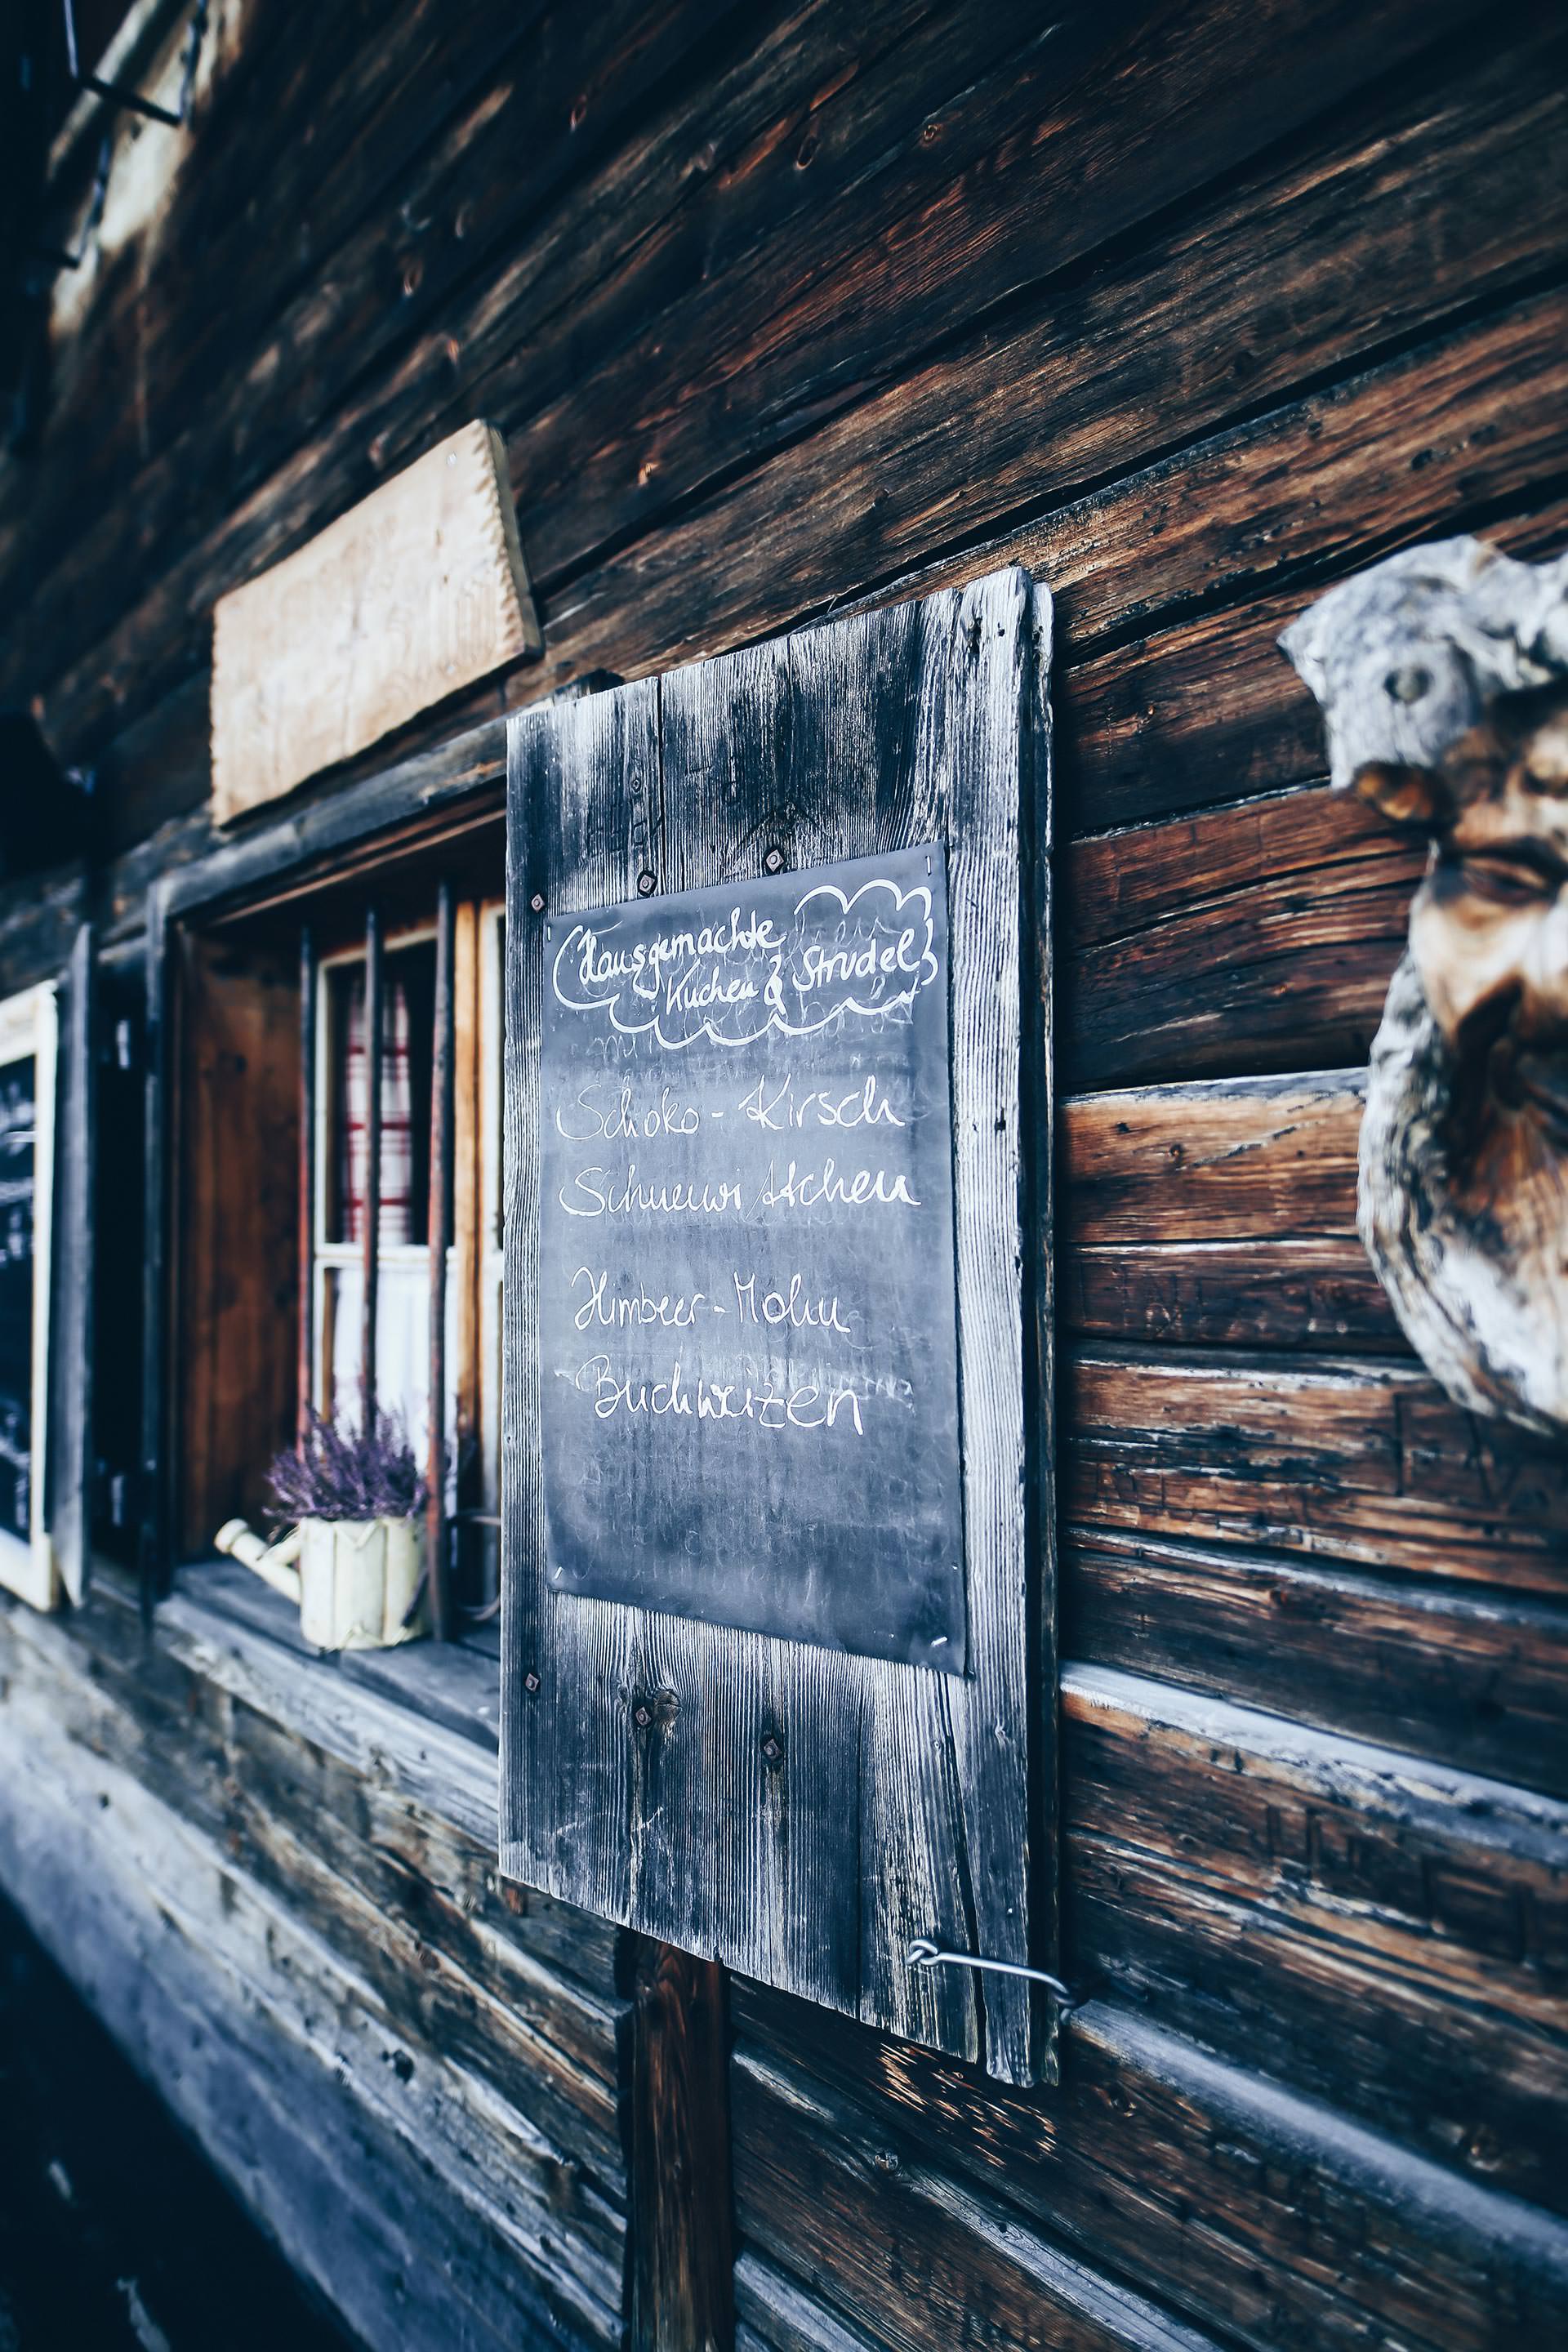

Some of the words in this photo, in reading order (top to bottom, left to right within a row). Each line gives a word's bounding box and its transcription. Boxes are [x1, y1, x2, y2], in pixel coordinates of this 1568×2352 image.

[578, 907, 786, 1000] Hausgemachte
[665, 963, 760, 1015] Kuchen
[792, 928, 920, 991] Strudel
[575, 1354, 864, 1436] Buchweizen
